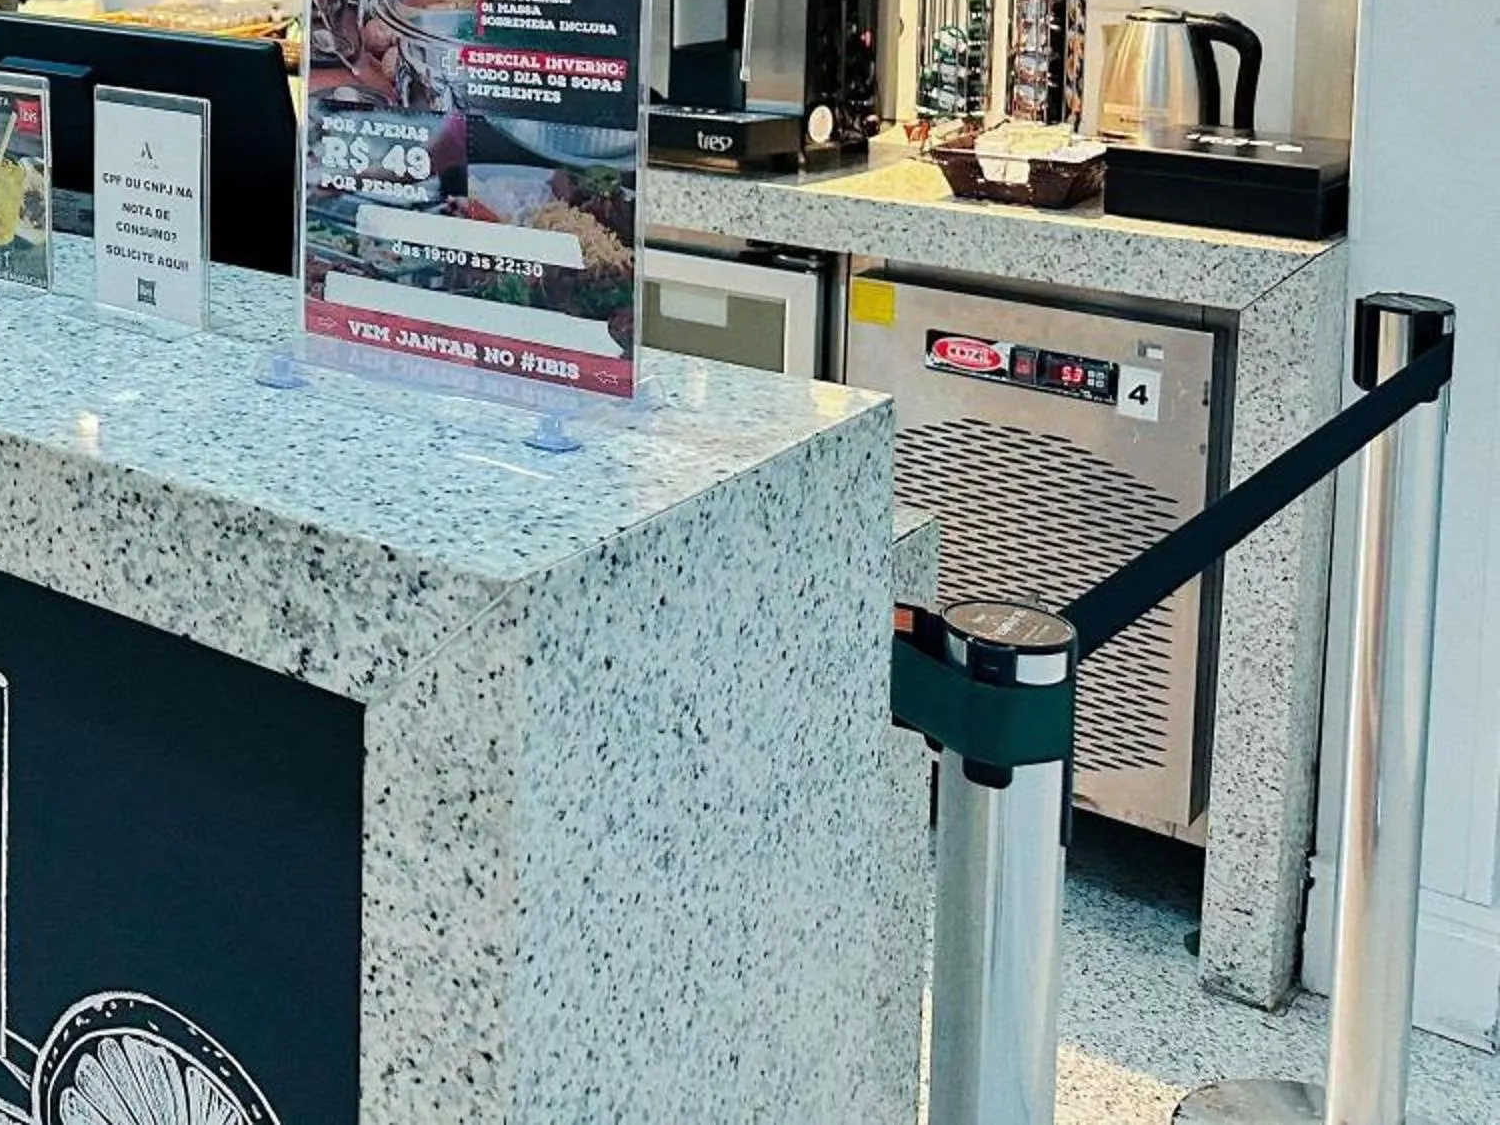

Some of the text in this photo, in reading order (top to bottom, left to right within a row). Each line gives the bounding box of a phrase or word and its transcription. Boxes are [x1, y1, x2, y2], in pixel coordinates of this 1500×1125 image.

[497, 3, 542, 16] MASSA
[480, 15, 618, 36] SOBREMESA INCLUSA
[467, 50, 627, 75] ESPECIAL INVERNO:
[467, 67, 509, 82] TODO
[513, 71, 543, 86] DIA
[571, 76, 623, 92] SOPAS
[467, 83, 562, 103] DIFERENTES
[322, 116, 429, 142] POR APENAS
[321, 136, 431, 180] R$ 49
[102, 172, 193, 199] CPF OU CNPJ NA
[322, 174, 429, 202] POR PESSOA
[122, 202, 171, 221] NOTA DE
[115, 221, 177, 243] CONSUMO?
[105, 244, 155, 264] SOLICITE
[392, 240, 543, 278] das 19:00 às 22:30
[348, 320, 580, 380] VEM JANTAR NO #IBIS
[1128, 384, 1149, 405] 4
